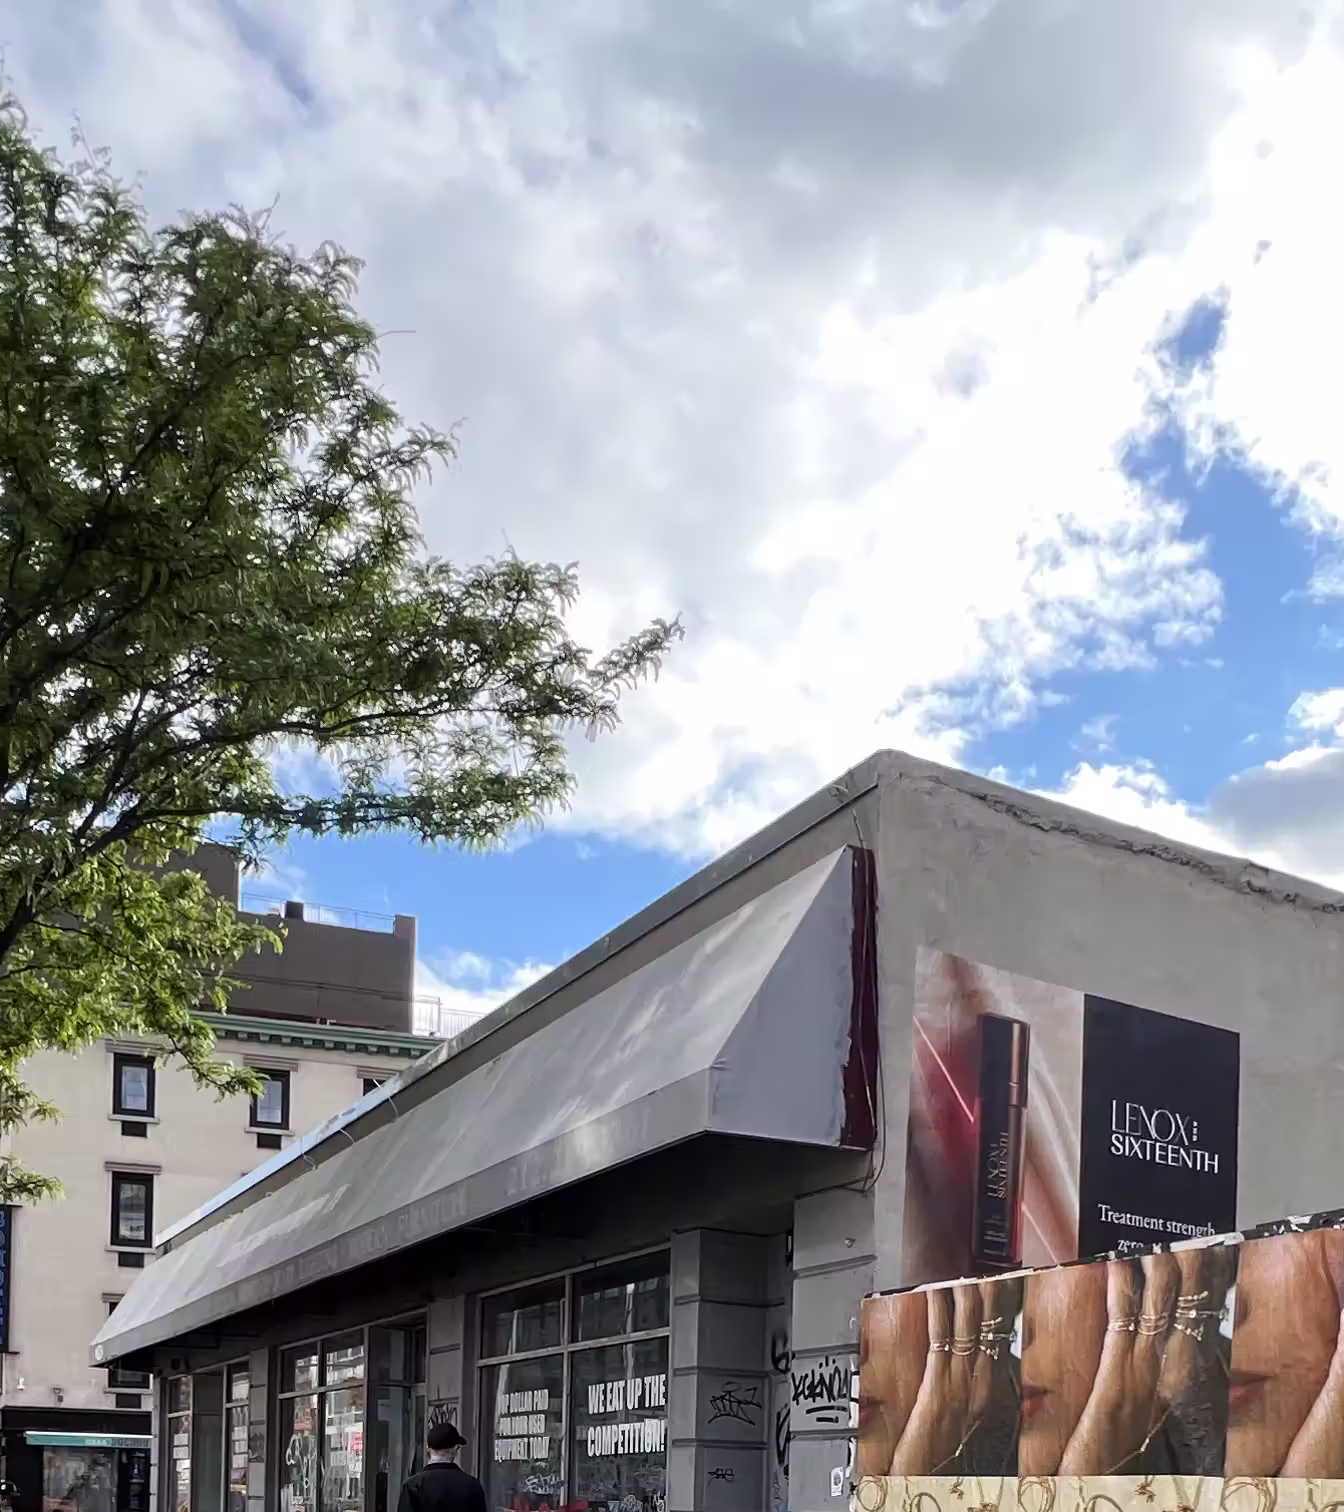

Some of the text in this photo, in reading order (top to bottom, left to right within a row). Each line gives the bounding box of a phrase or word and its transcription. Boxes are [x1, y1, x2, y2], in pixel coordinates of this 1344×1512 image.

[1111, 1099, 1190, 1146] LENOX
[1110, 1133, 1219, 1175] SIXTEENTH
[1097, 1203, 1164, 1232] Treatment
[588, 1373, 666, 1415] WE EAT UP THE
[587, 1418, 665, 1457] COMPETITION!
